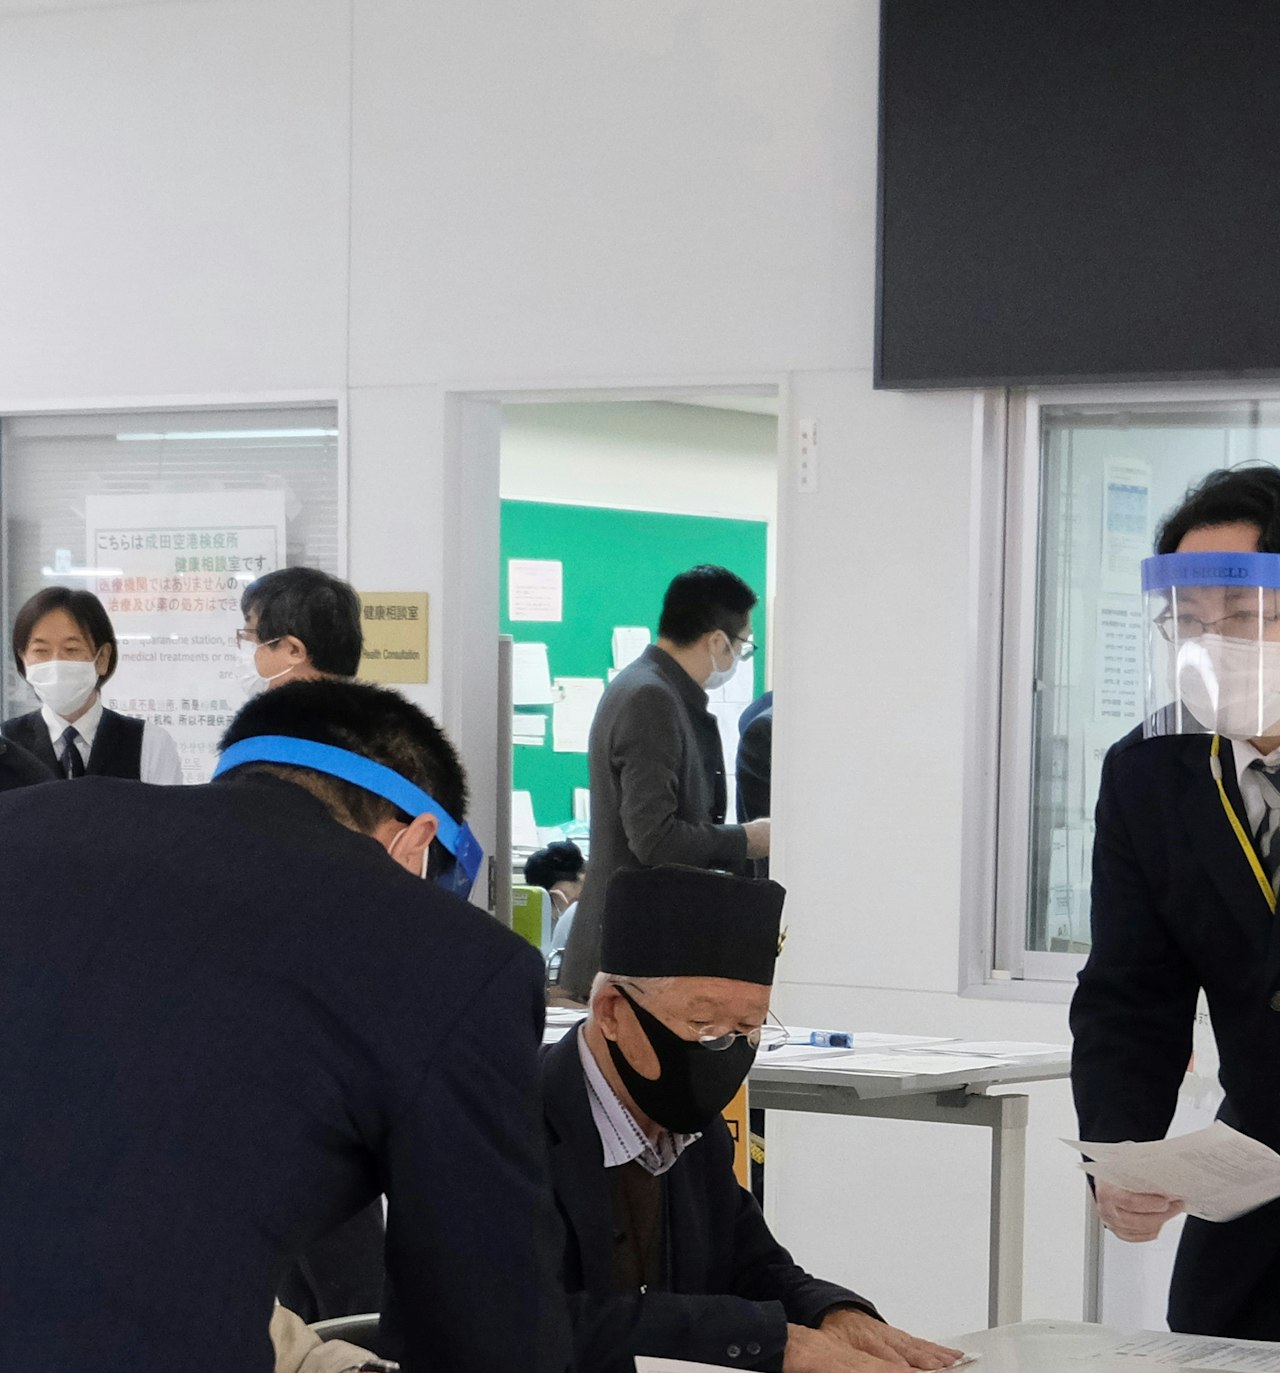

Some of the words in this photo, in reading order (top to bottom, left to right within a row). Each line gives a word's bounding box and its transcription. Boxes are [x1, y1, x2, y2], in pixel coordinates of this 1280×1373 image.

[363, 605, 419, 620] 健康相談室
